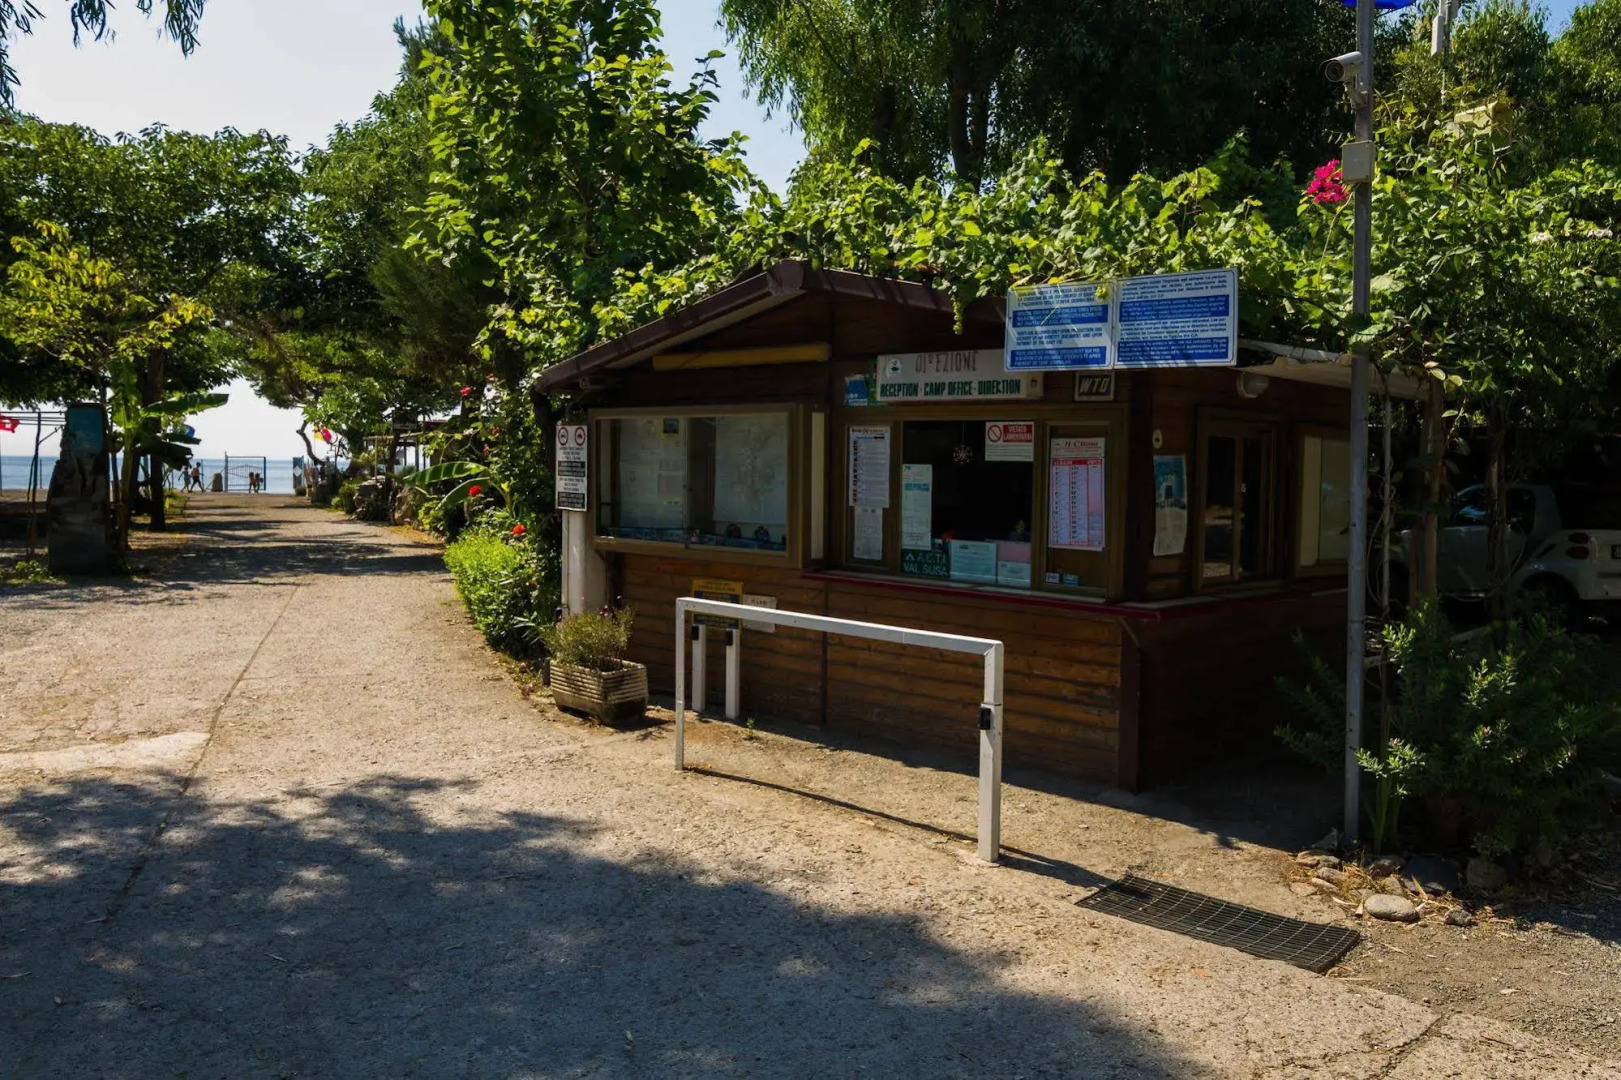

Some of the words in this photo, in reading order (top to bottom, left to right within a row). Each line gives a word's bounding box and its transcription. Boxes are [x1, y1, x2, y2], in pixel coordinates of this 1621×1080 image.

[880, 382, 918, 397] RECEPTION
[923, 381, 946, 396] CAMP
[947, 380, 972, 396] OFFICE
[978, 378, 1021, 395] DIREKTION
